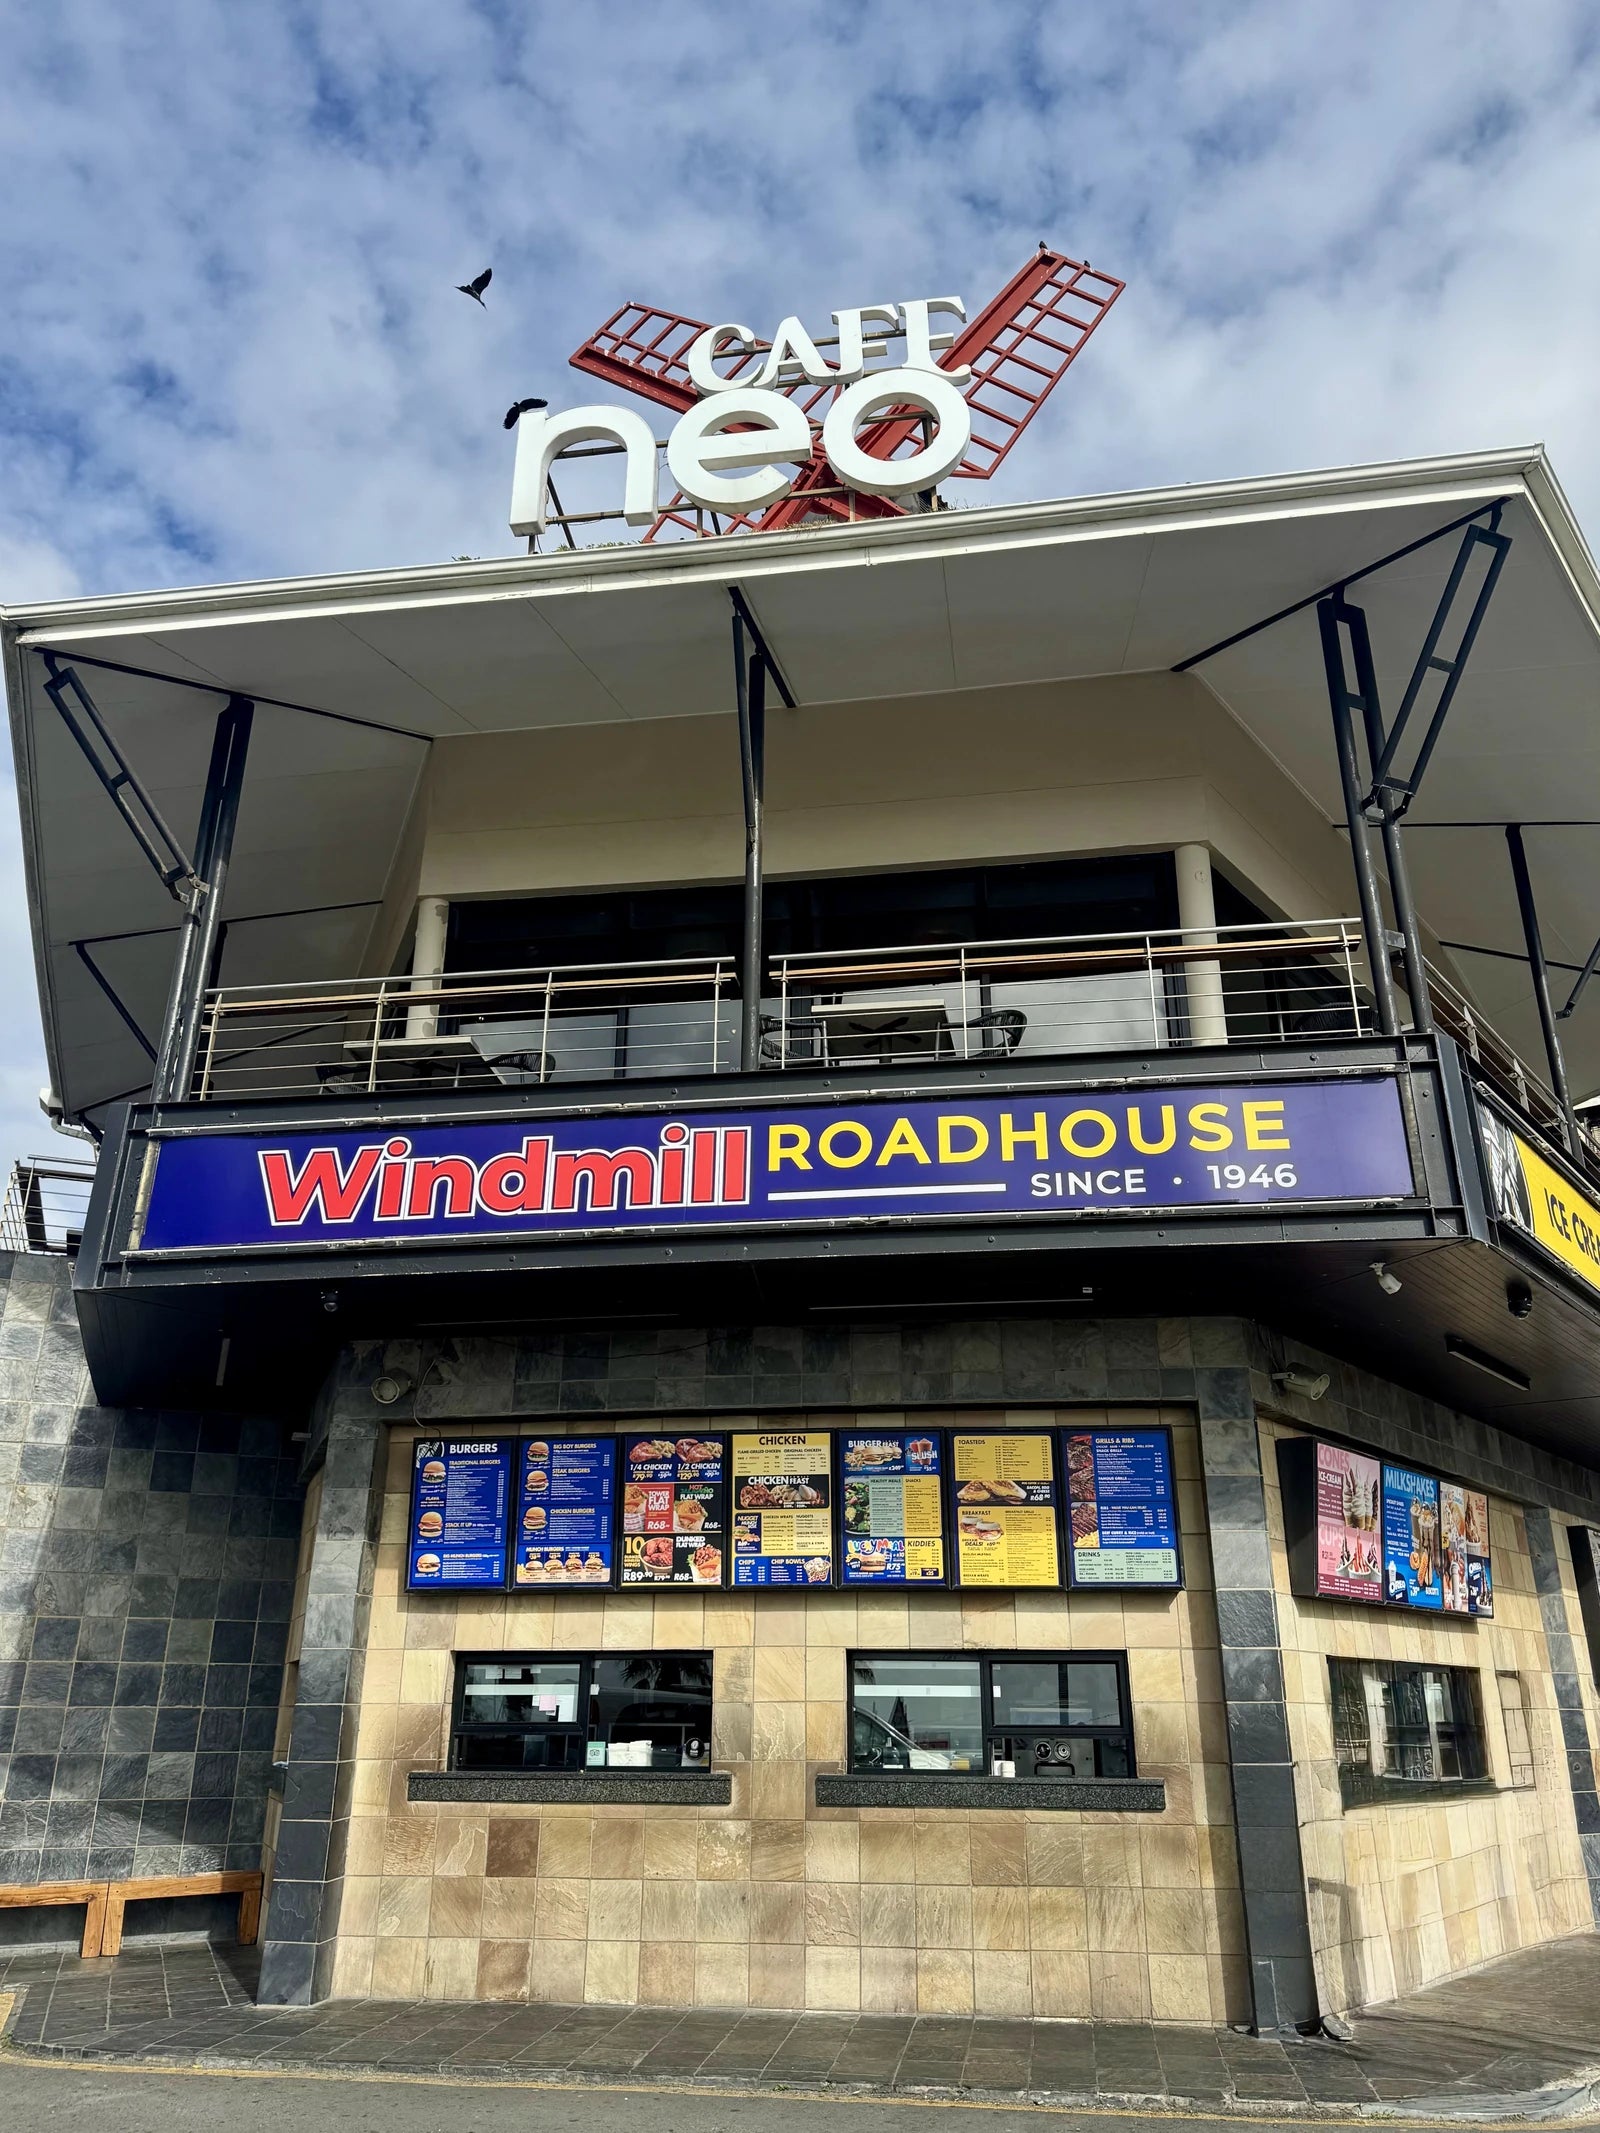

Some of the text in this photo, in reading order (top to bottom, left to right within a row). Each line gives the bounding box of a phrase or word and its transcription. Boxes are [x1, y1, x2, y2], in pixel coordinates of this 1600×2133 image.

[687, 296, 972, 396] CAFE
[509, 369, 971, 537] neo
[257, 1100, 1291, 1226] Windmill ROADHOUSE
[1031, 1163, 1298, 1197] SINCE 1946
[1543, 1187, 1572, 1243] ICE
[449, 1443, 498, 1454] BURGERS
[759, 1435, 806, 1446] CHICKEN
[848, 1440, 881, 1448] BURGER
[911, 1450, 938, 1460] SLUSH
[1318, 1445, 1350, 1472] CONES
[748, 1476, 789, 1485] CHICKEN
[1385, 1468, 1435, 1498] MILKSHAKES
[648, 1496, 669, 1505] FLAT
[624, 1536, 645, 1555] 10
